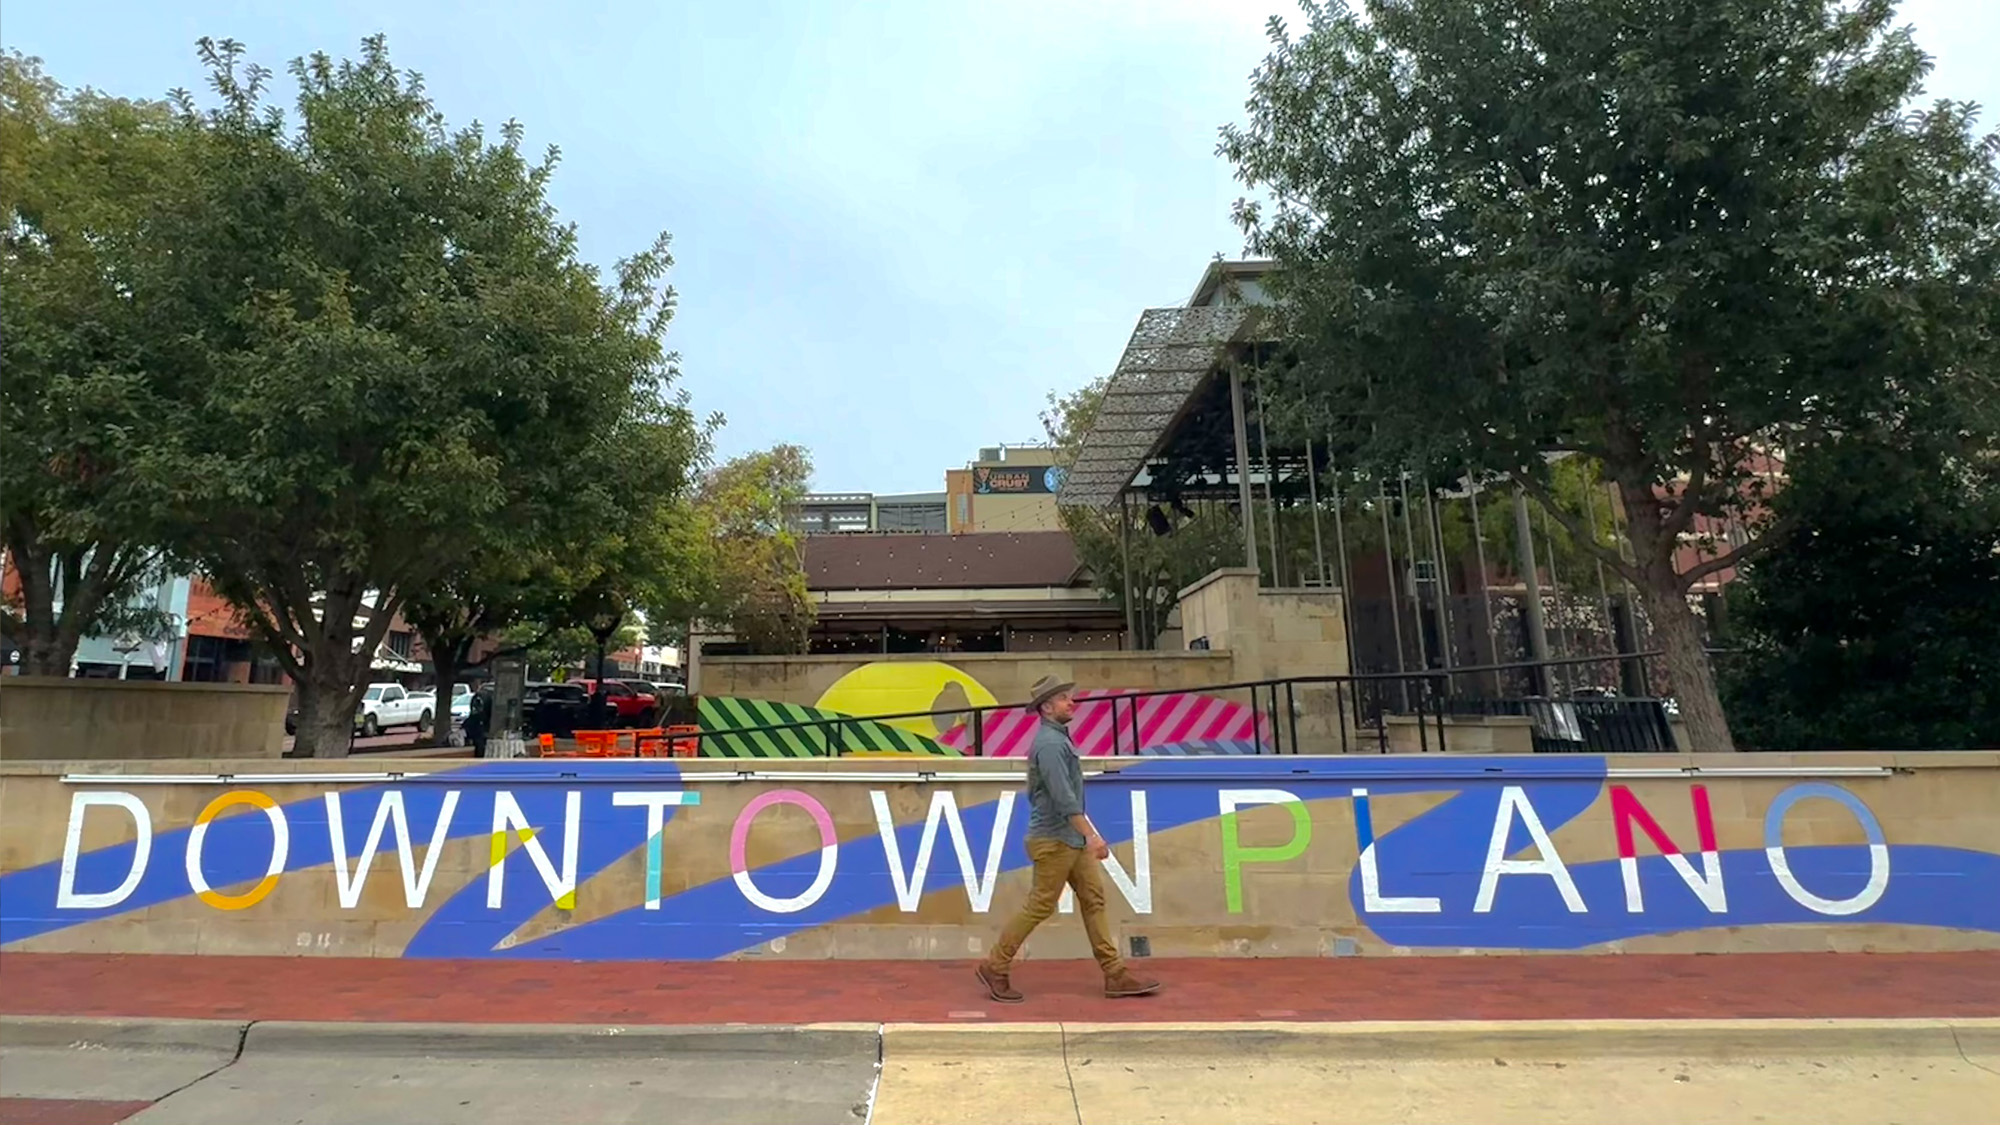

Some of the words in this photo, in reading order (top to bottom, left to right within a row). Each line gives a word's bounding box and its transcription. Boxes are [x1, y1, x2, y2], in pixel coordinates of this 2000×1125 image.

[989, 479, 1029, 488] CRUST
[56, 788, 1153, 914] DOWNTOWN
[1219, 782, 1891, 916] PLANO
